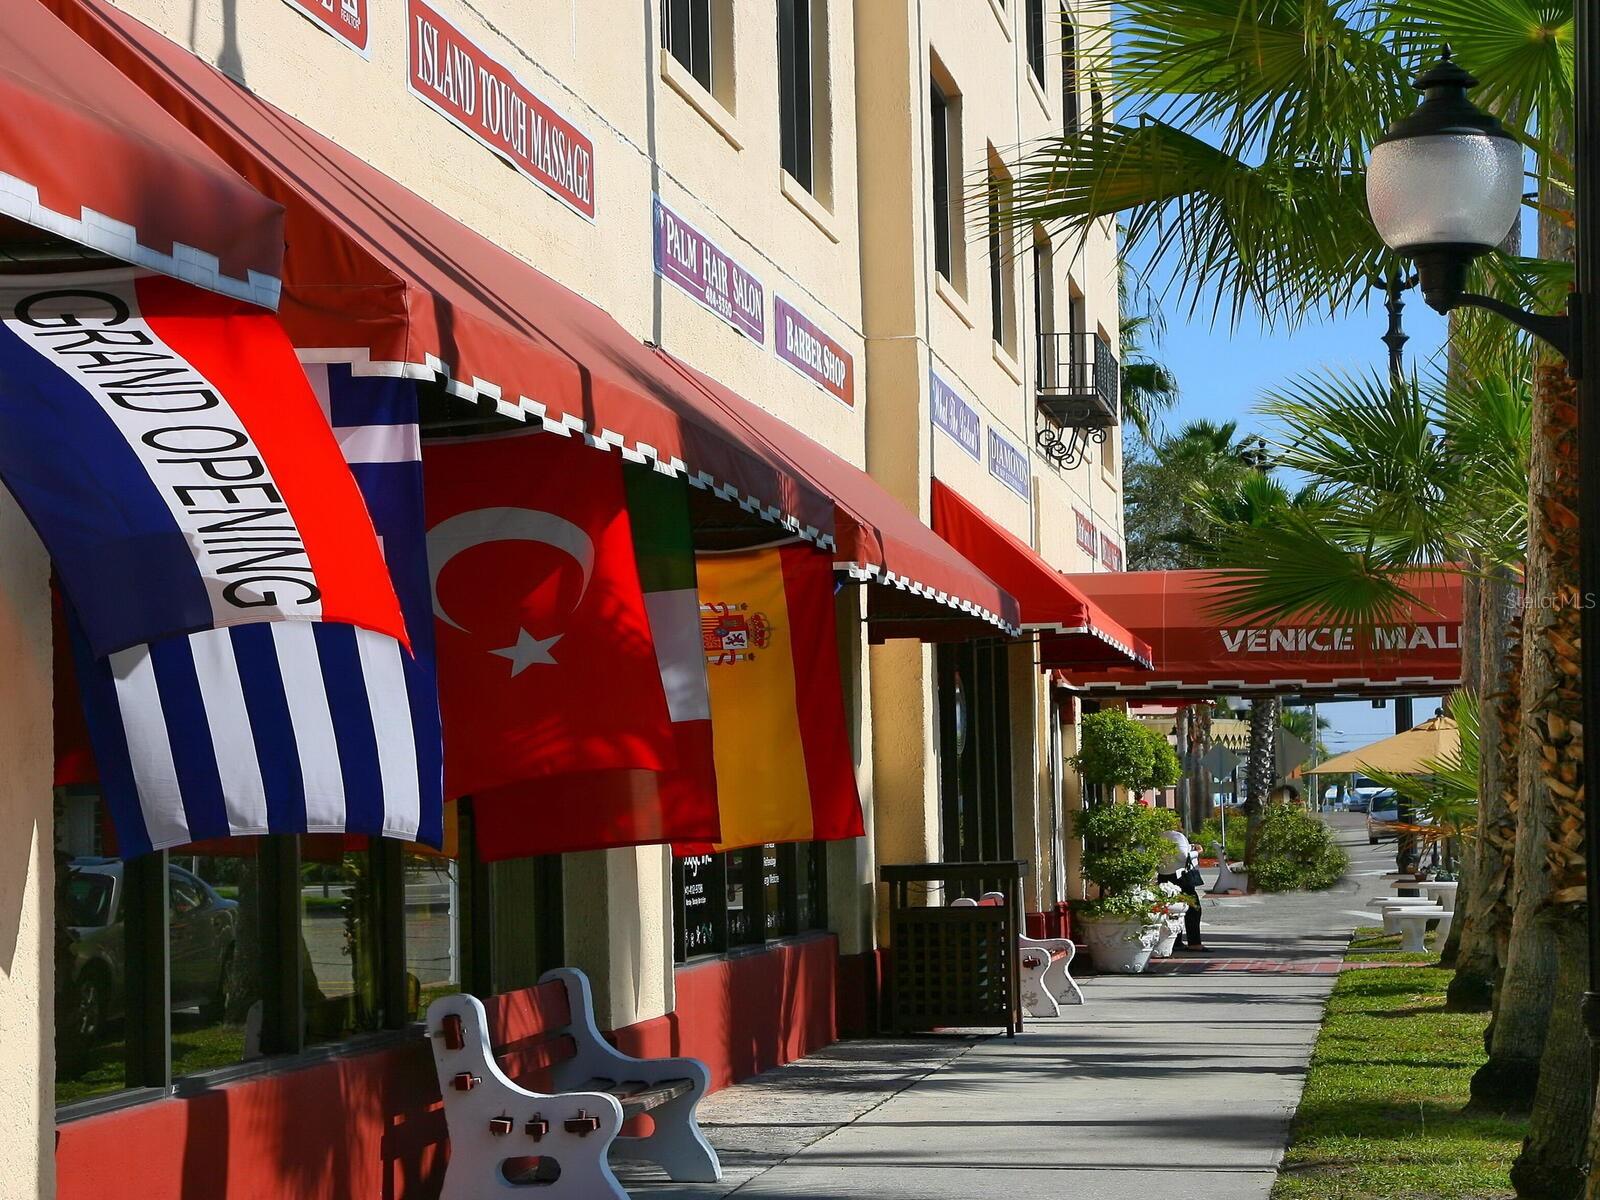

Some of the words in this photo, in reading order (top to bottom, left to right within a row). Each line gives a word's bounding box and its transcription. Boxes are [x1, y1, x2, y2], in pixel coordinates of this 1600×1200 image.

[416, 16, 475, 116] ISLAND
[479, 66, 528, 159] TOUCH
[530, 108, 591, 205] MASSAGE
[666, 213, 697, 274] PALM
[702, 242, 729, 298] HAIR
[732, 267, 762, 322] SALON
[786, 314, 823, 379] BARBER
[822, 344, 846, 390] SHOP
[14, 289, 219, 413] GRAND
[141, 425, 322, 608] OPENING
[1219, 627, 1355, 652] VENICE
[1372, 626, 1463, 650] MAL
